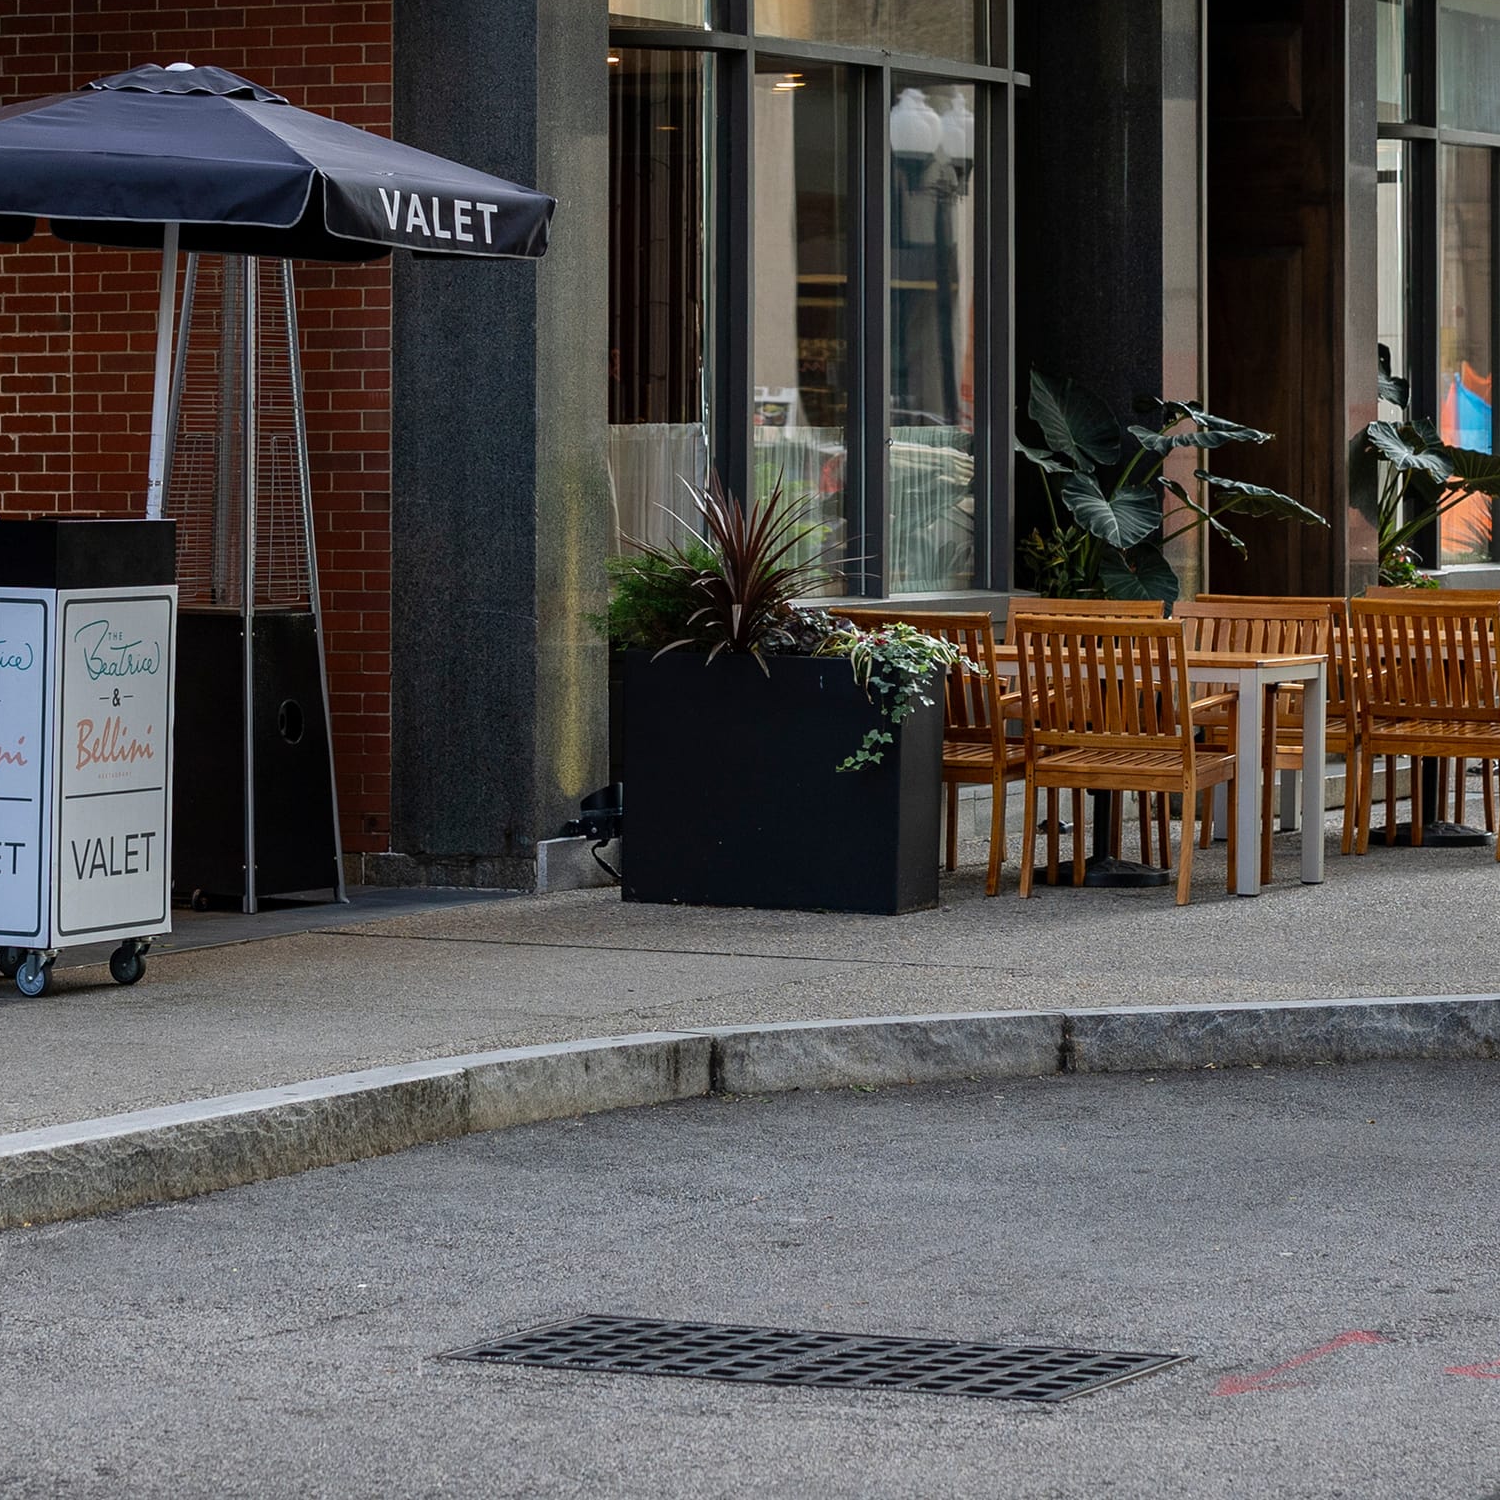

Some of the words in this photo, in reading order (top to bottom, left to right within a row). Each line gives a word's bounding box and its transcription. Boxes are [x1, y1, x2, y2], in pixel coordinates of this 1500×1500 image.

[378, 187, 499, 245] VALET
[74, 619, 161, 681] Beatrice
[107, 631, 124, 641] THE
[112, 688, 121, 707] &
[76, 716, 154, 770] Bellini
[71, 831, 156, 880] VALET
